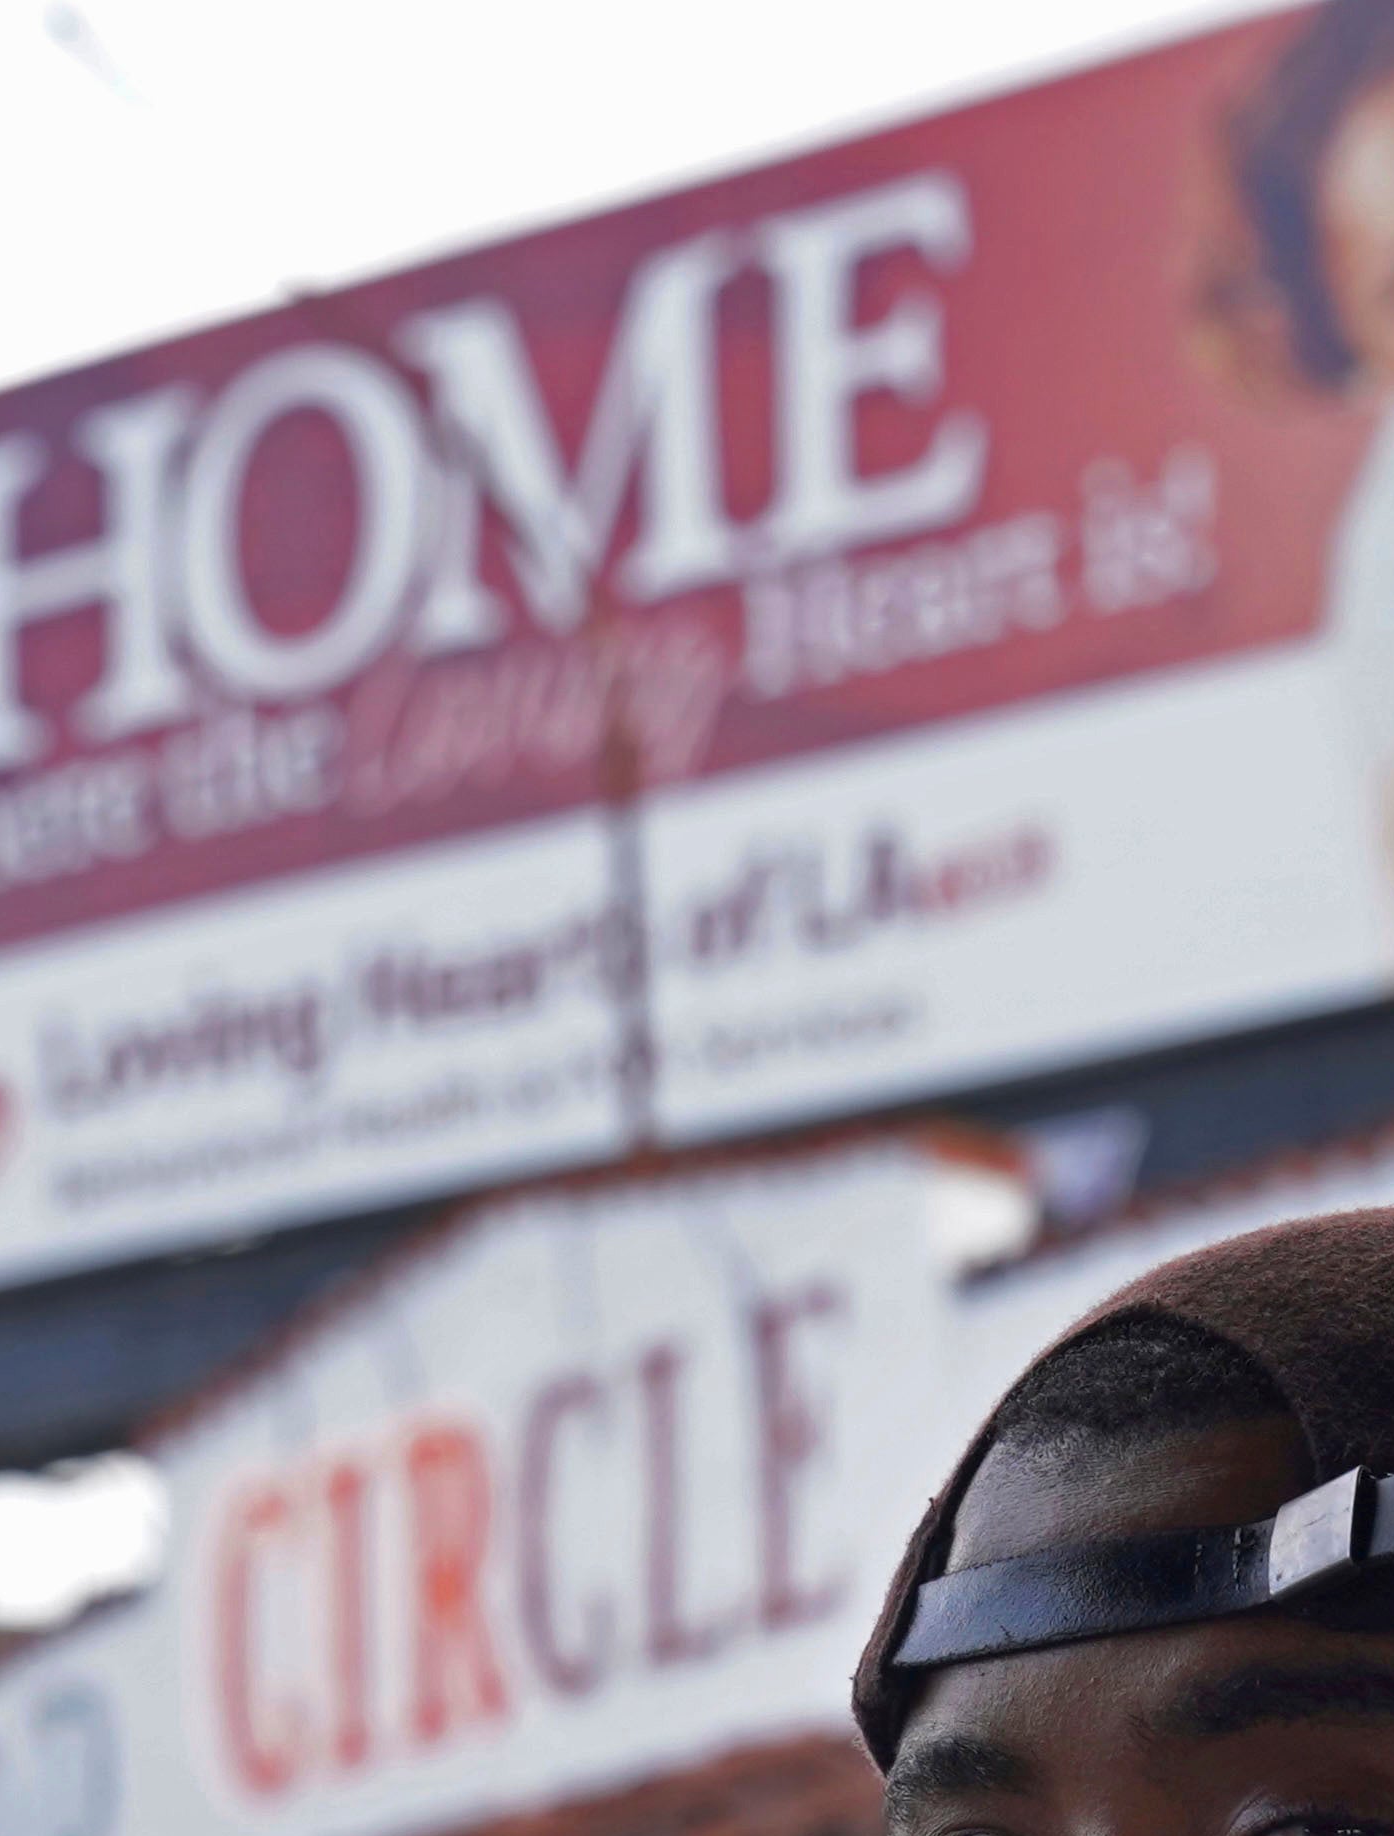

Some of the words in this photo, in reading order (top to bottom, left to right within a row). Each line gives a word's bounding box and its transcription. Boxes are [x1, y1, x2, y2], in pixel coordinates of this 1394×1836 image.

[156, 693, 344, 842] the
[741, 508, 1069, 703] Heart
[34, 970, 328, 1118] Loving
[344, 898, 651, 1035] Heart
[211, 1280, 846, 1800] CIRCLE
